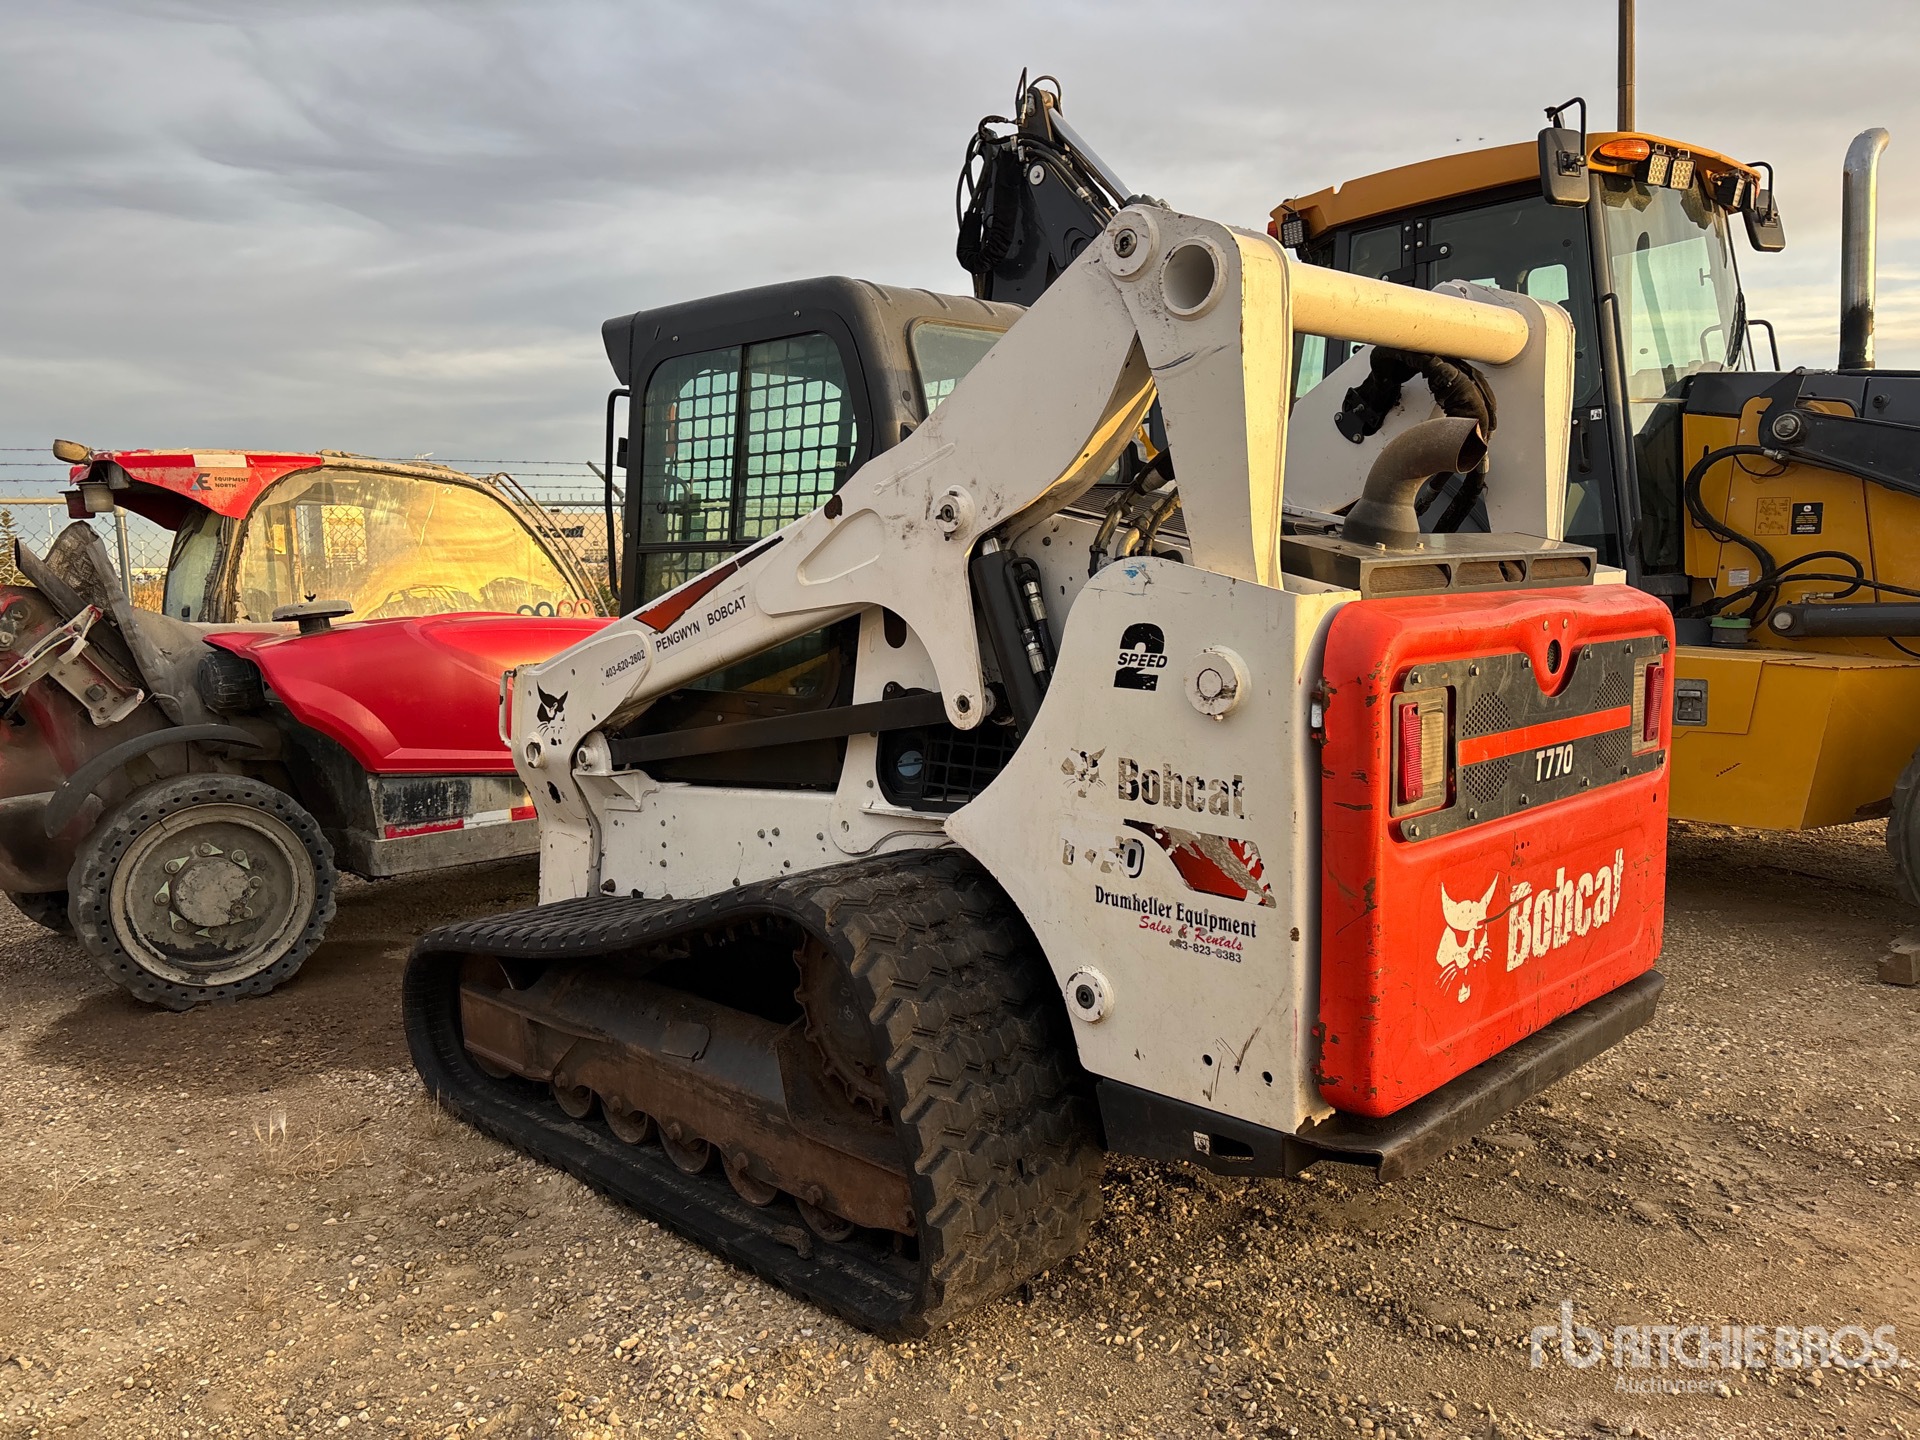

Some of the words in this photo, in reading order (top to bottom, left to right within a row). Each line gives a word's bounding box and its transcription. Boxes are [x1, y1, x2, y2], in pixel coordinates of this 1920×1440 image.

[655, 620, 701, 652] PENGWYN
[707, 595, 748, 626] BOBCAT
[605, 649, 646, 679] 403-620-2802
[1113, 622, 1165, 692] 2
[1117, 652, 1168, 669] SPEED
[1117, 757, 1245, 820] Bobcat
[1536, 743, 1574, 782] T770
[1095, 884, 1173, 919] Drumheller
[1176, 901, 1257, 938] Equipment
[1138, 915, 1173, 935] Sales
[1194, 926, 1244, 951] Rentals
[1506, 848, 1625, 973] Bobcat
